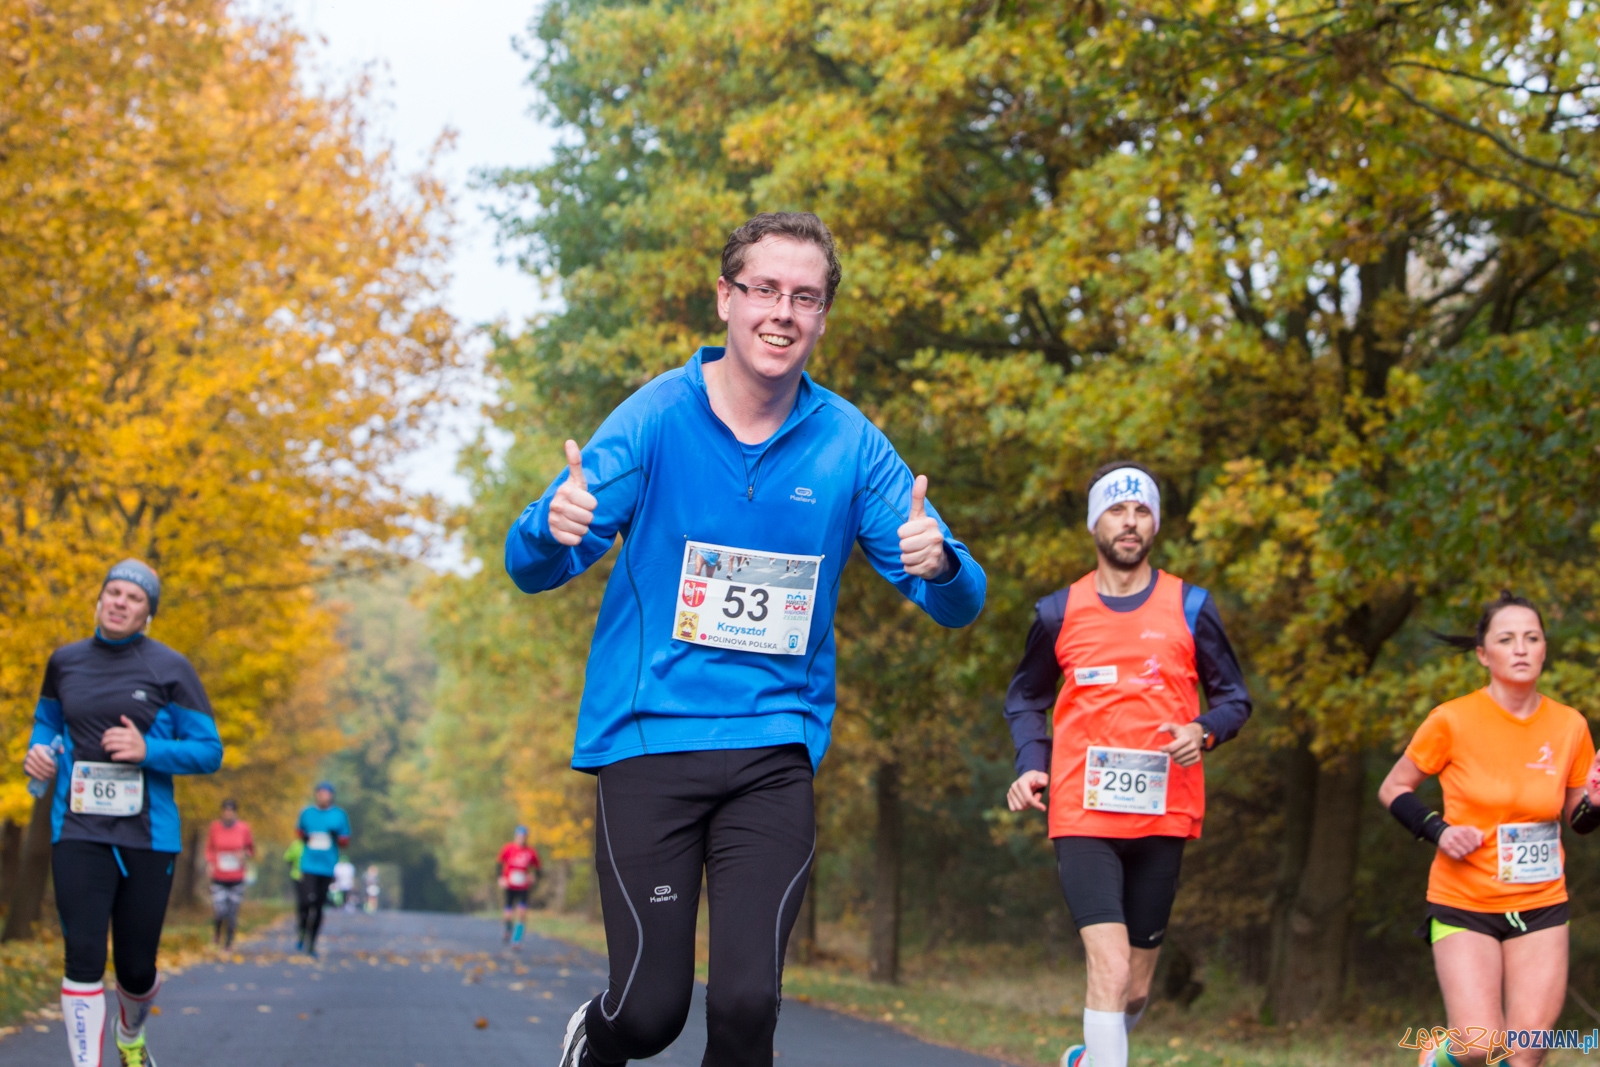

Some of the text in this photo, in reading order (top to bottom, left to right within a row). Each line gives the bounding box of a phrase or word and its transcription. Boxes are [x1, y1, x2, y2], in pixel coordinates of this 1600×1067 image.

[721, 585, 770, 622] 53
[717, 621, 767, 637] Krzysztof
[708, 635, 747, 647] POLINOVA
[748, 640, 778, 650] POLSKA
[93, 781, 116, 799] 66
[1103, 770, 1147, 794] 296
[1516, 843, 1550, 865] 299
[650, 893, 678, 903] Kalenji
